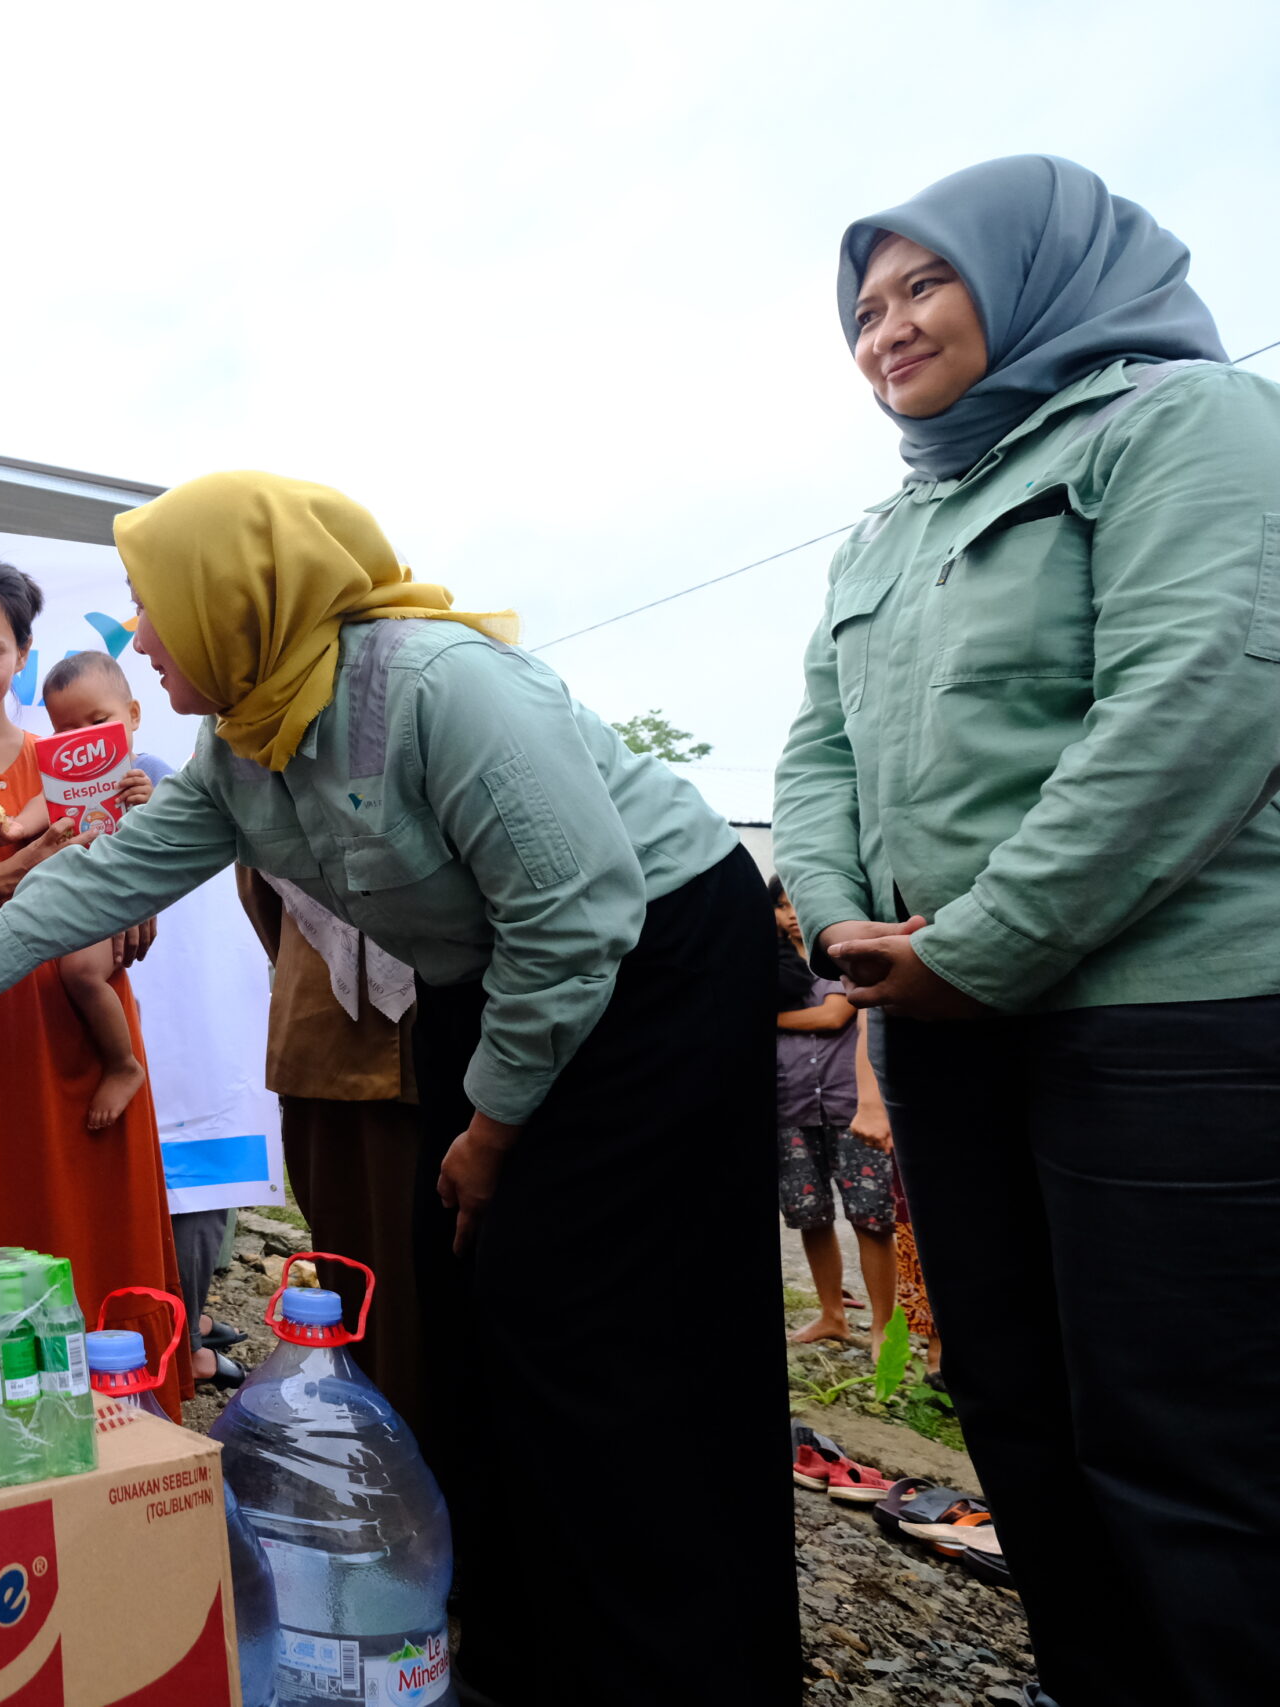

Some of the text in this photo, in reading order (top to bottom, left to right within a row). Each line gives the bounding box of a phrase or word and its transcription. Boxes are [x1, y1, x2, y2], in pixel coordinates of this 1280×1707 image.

[60, 739, 106, 772] SGM
[63, 781, 117, 800] Eksplor
[109, 1466, 211, 1504] GUNAKAN SEBELUM:
[146, 1488, 214, 1523] (TGL/BLN/THN)
[427, 1637, 440, 1661] Le
